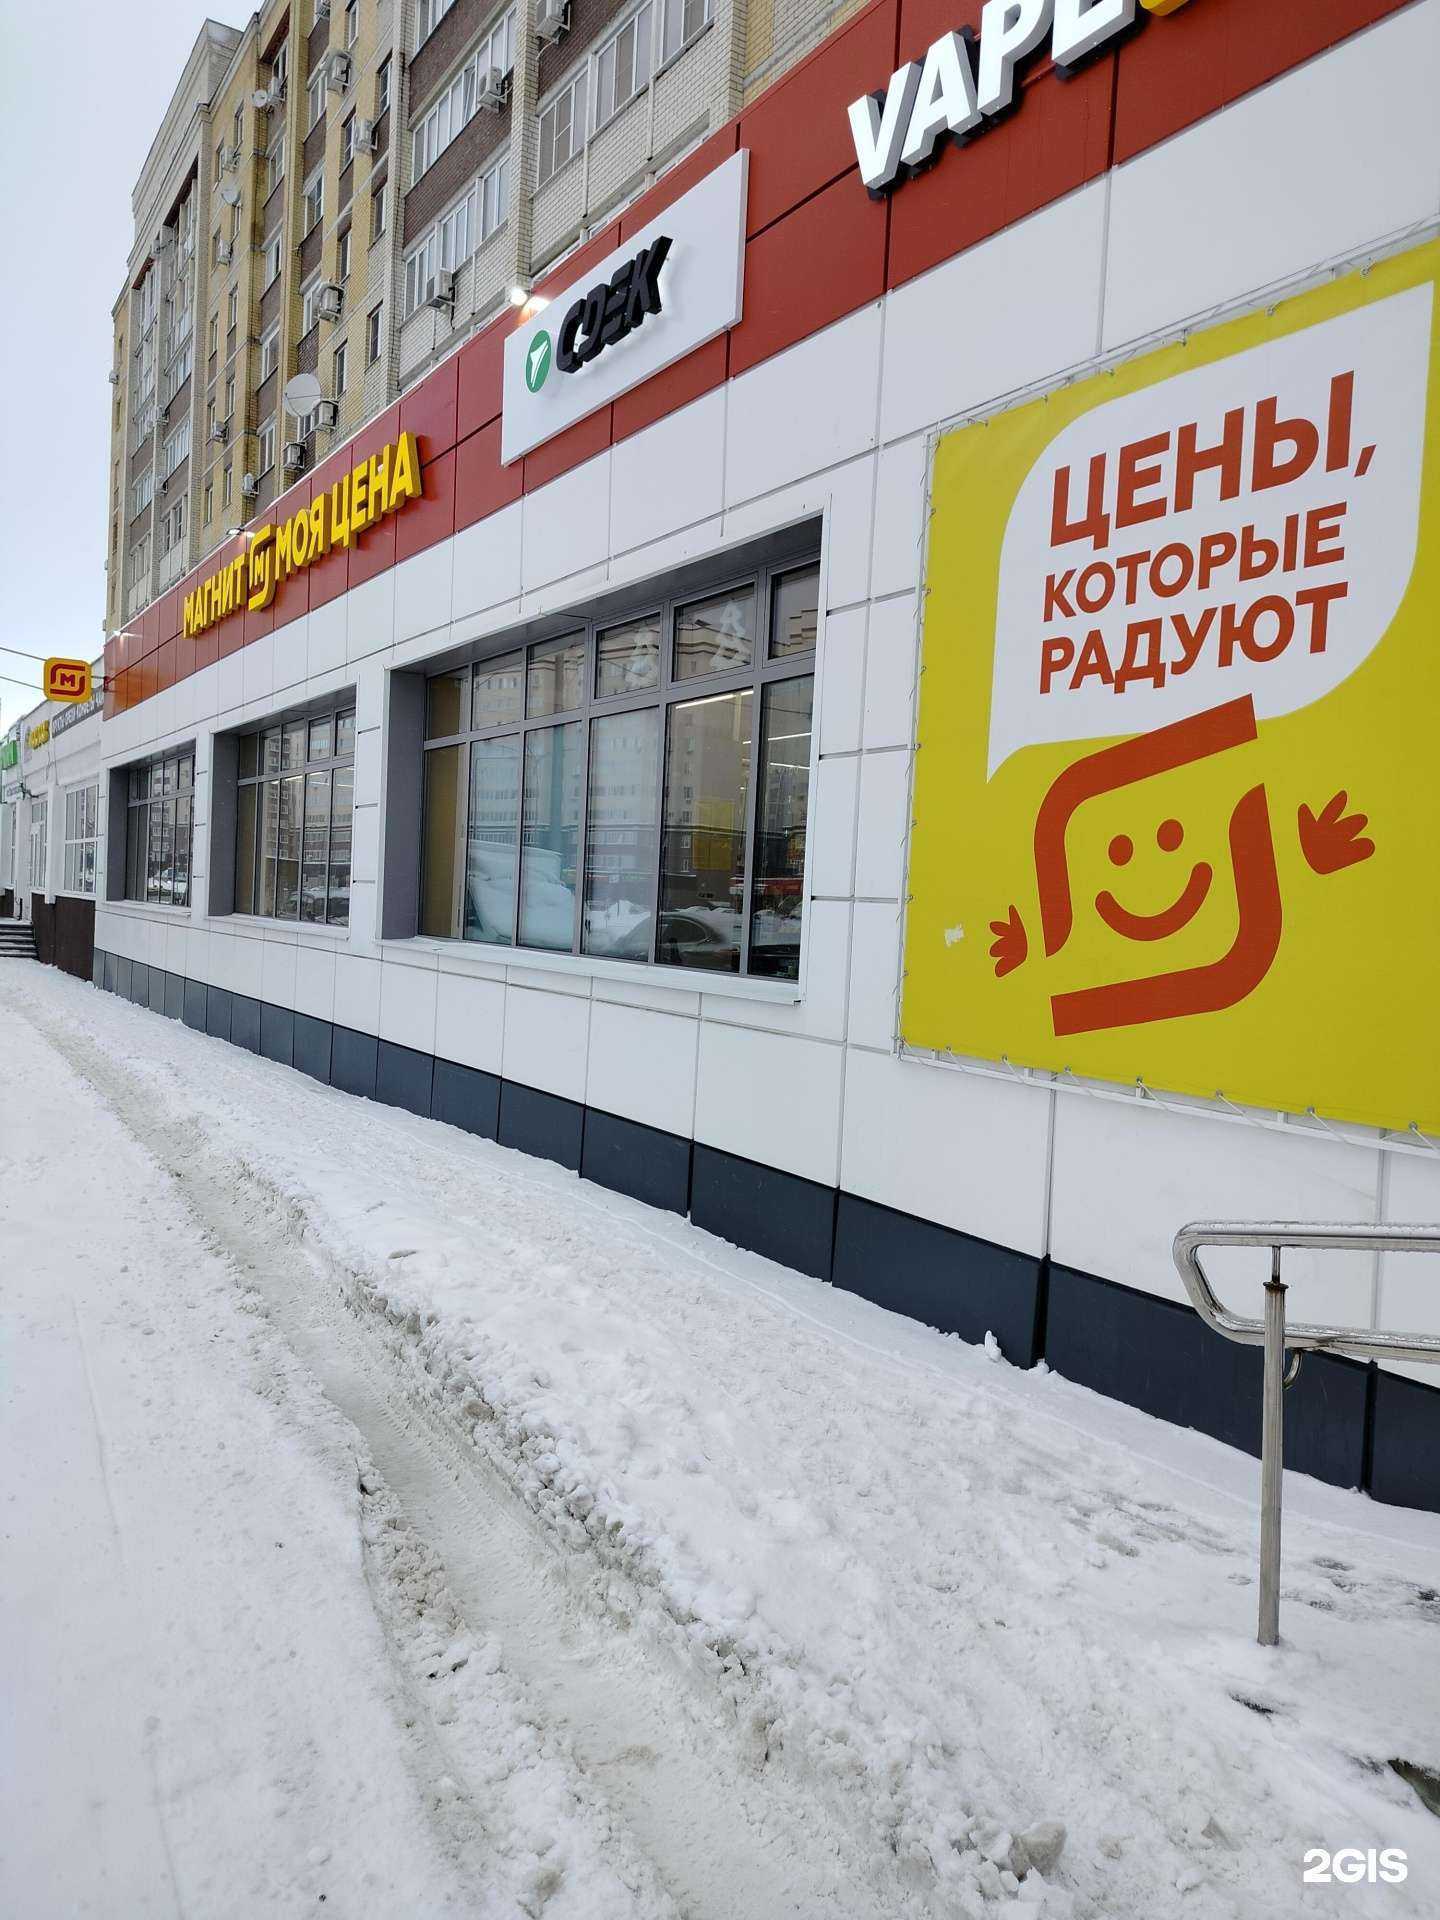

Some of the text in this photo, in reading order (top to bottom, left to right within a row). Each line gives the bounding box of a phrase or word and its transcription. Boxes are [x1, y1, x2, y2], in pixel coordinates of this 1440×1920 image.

[183, 552, 248, 639] МАГНИТ
[275, 492, 331, 581] МОЯ
[331, 431, 422, 548] ЦЕНА
[1050, 370, 1377, 551] ЦЕНЫ,
[1043, 501, 1347, 622] КОТОРЫЕ
[1039, 581, 1349, 695] РАДУЮТ
